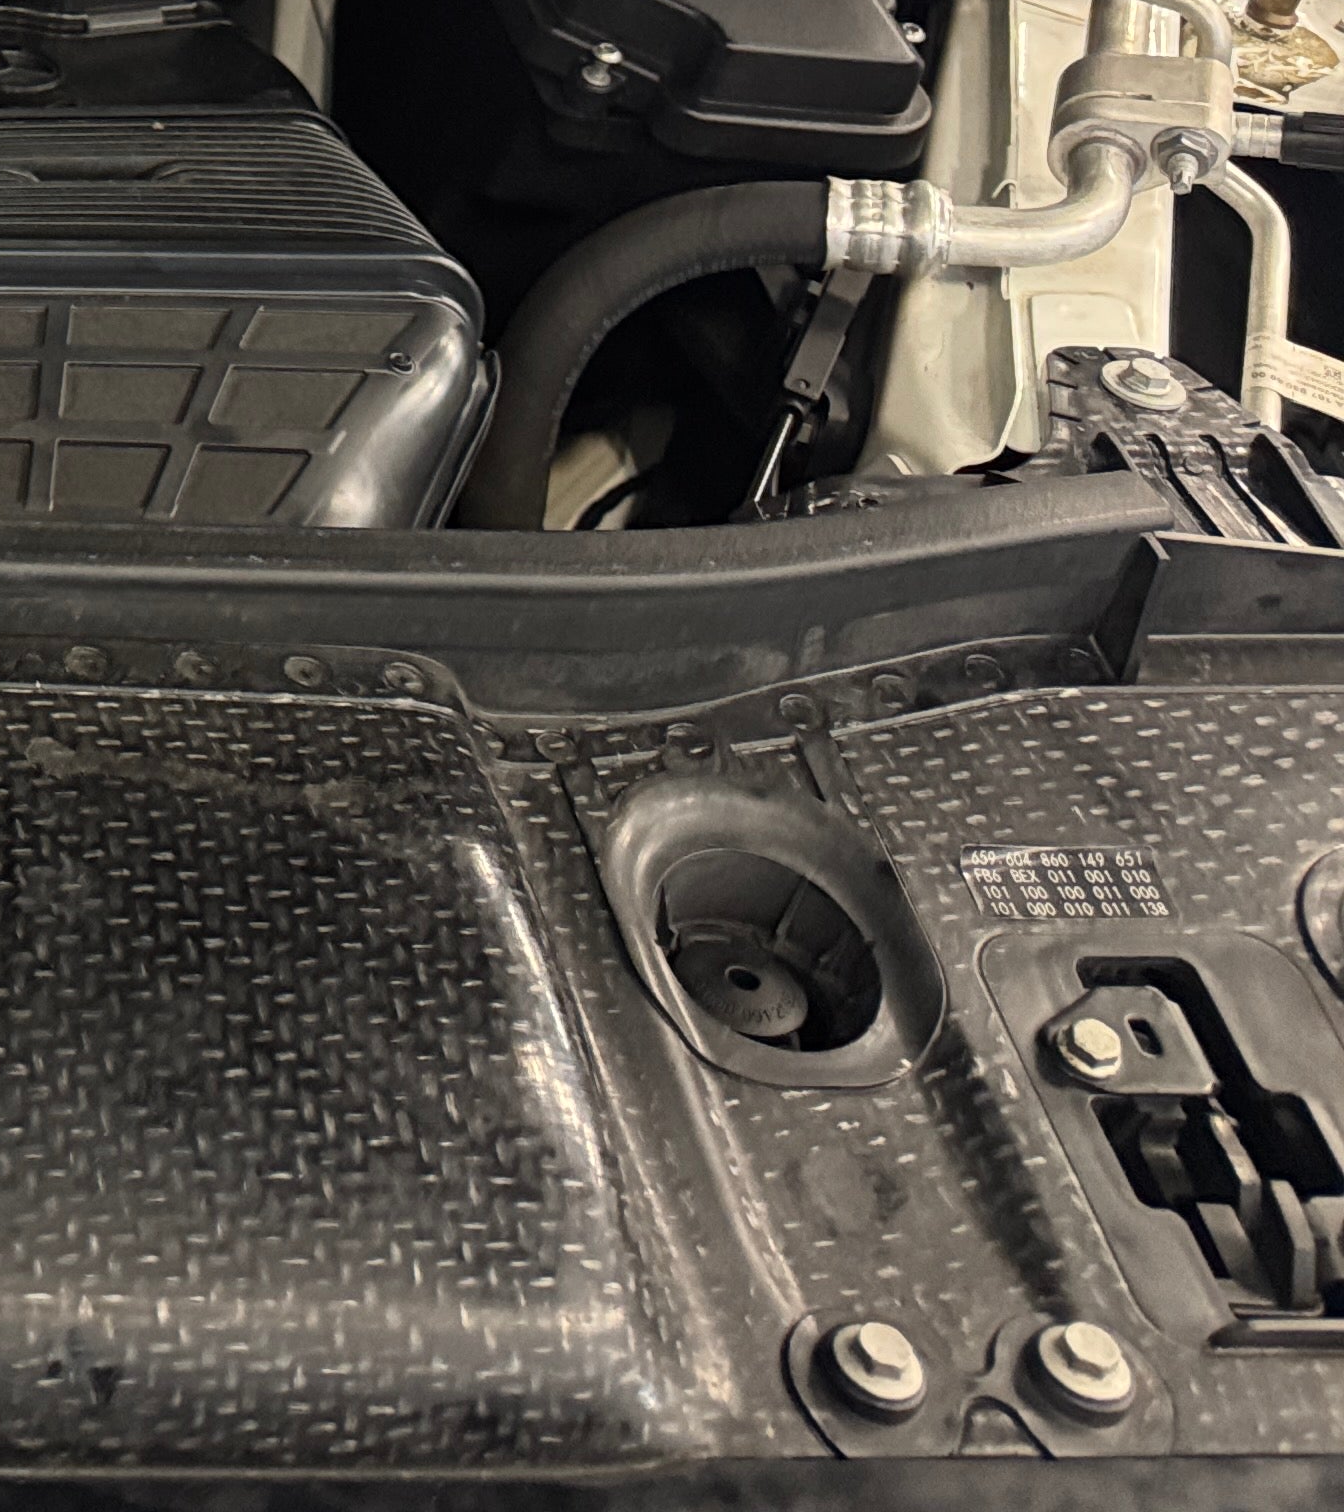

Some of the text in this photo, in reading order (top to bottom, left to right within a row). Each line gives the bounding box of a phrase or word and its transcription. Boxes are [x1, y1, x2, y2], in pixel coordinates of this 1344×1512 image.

[1006, 852, 1031, 866] 604
[1040, 852, 1068, 867] 860
[1078, 852, 1104, 867] 149
[1115, 851, 1142, 867] 651
[974, 868, 1151, 883] FB6 BEX 011 001 010
[983, 885, 1160, 900] 101 100 100 011 000
[991, 902, 1169, 916] 101 000 010 011 138
